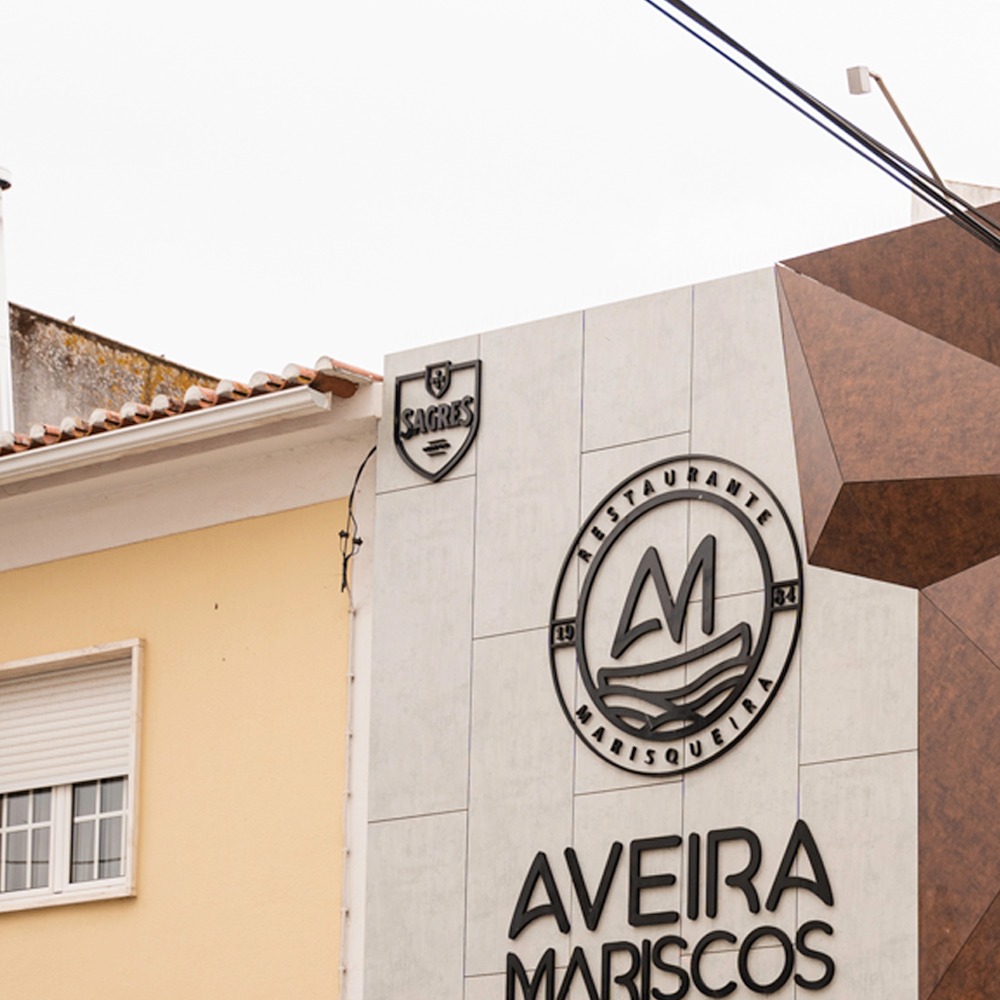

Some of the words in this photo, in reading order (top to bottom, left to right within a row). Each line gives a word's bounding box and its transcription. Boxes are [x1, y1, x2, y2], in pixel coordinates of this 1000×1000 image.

[400, 395, 474, 440] SAGRES
[577, 466, 773, 564] RESTAURANTE
[556, 625, 575, 643] 19
[575, 676, 773, 766] MARISQUEIRA
[508, 819, 834, 940] AVEIRA
